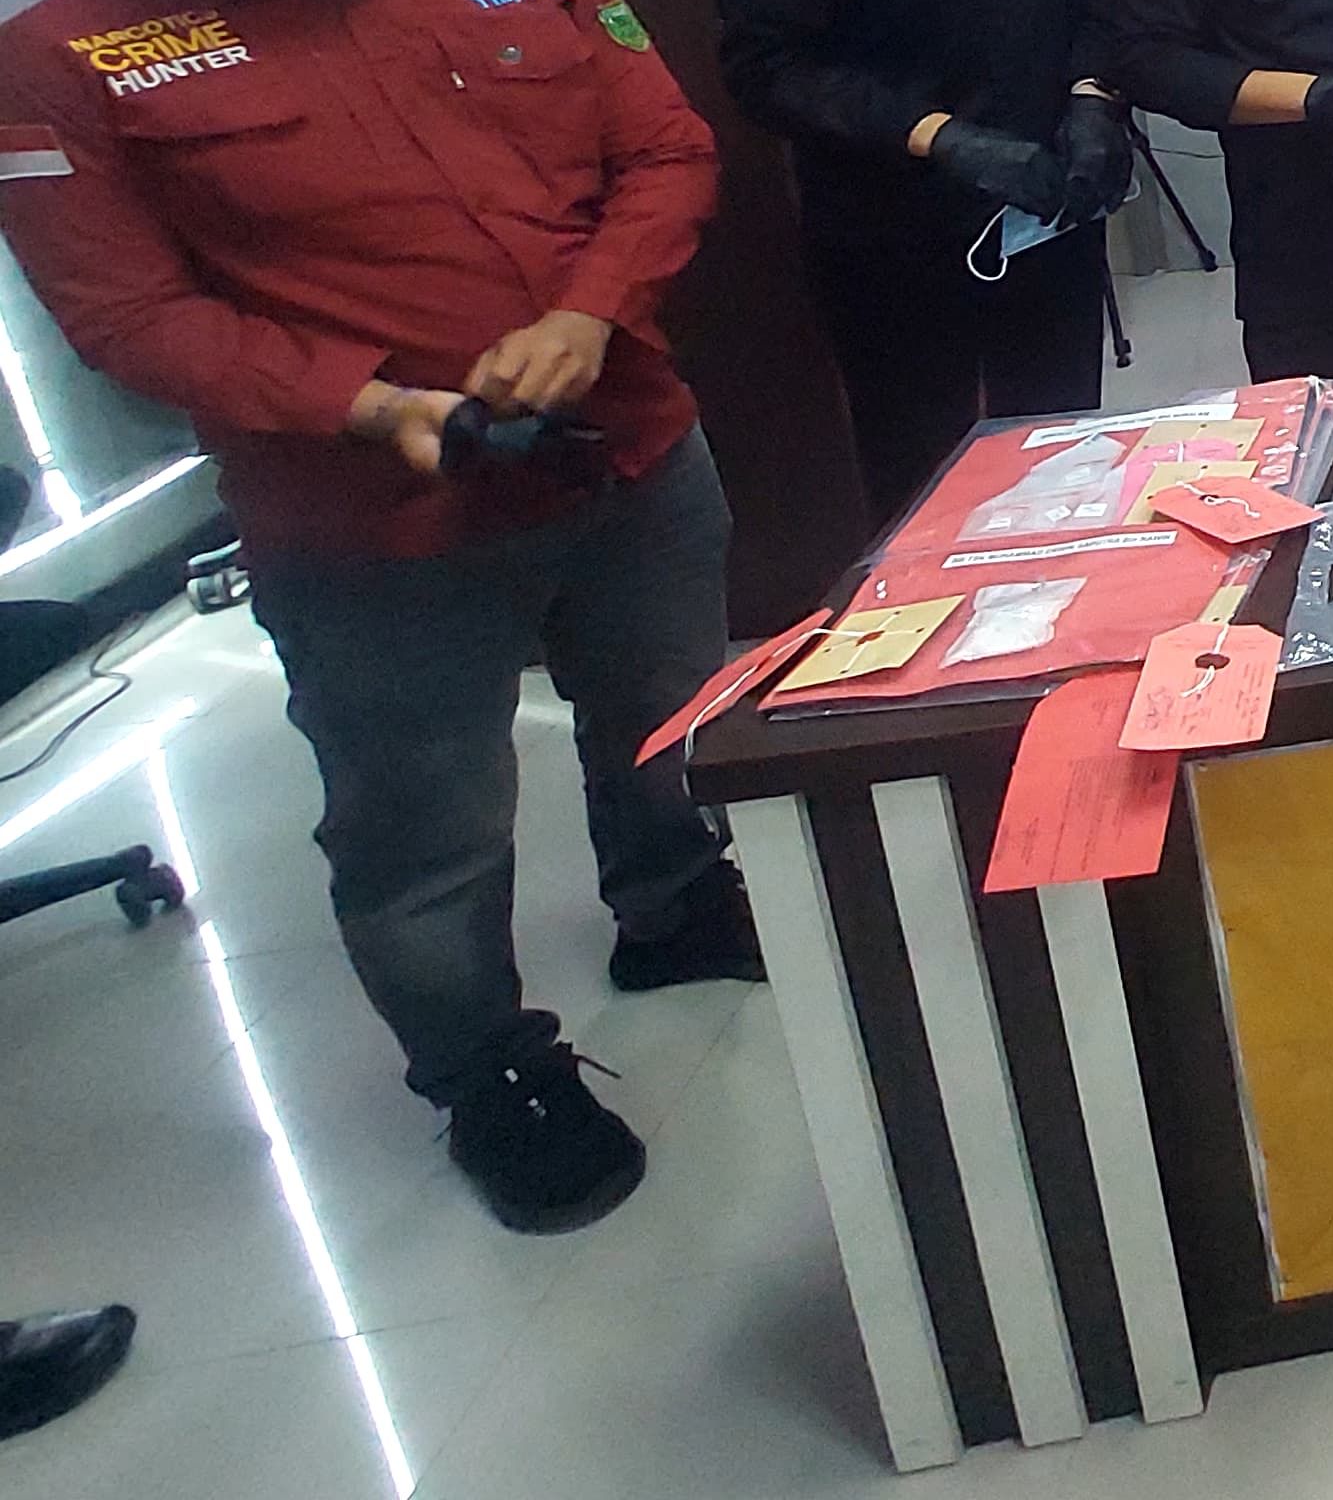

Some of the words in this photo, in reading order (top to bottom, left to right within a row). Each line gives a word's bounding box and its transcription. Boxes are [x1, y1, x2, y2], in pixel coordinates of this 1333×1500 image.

[68, 9, 220, 53] NARCOTICS
[90, 19, 241, 72] CRIME
[106, 45, 256, 97] HUNTER
